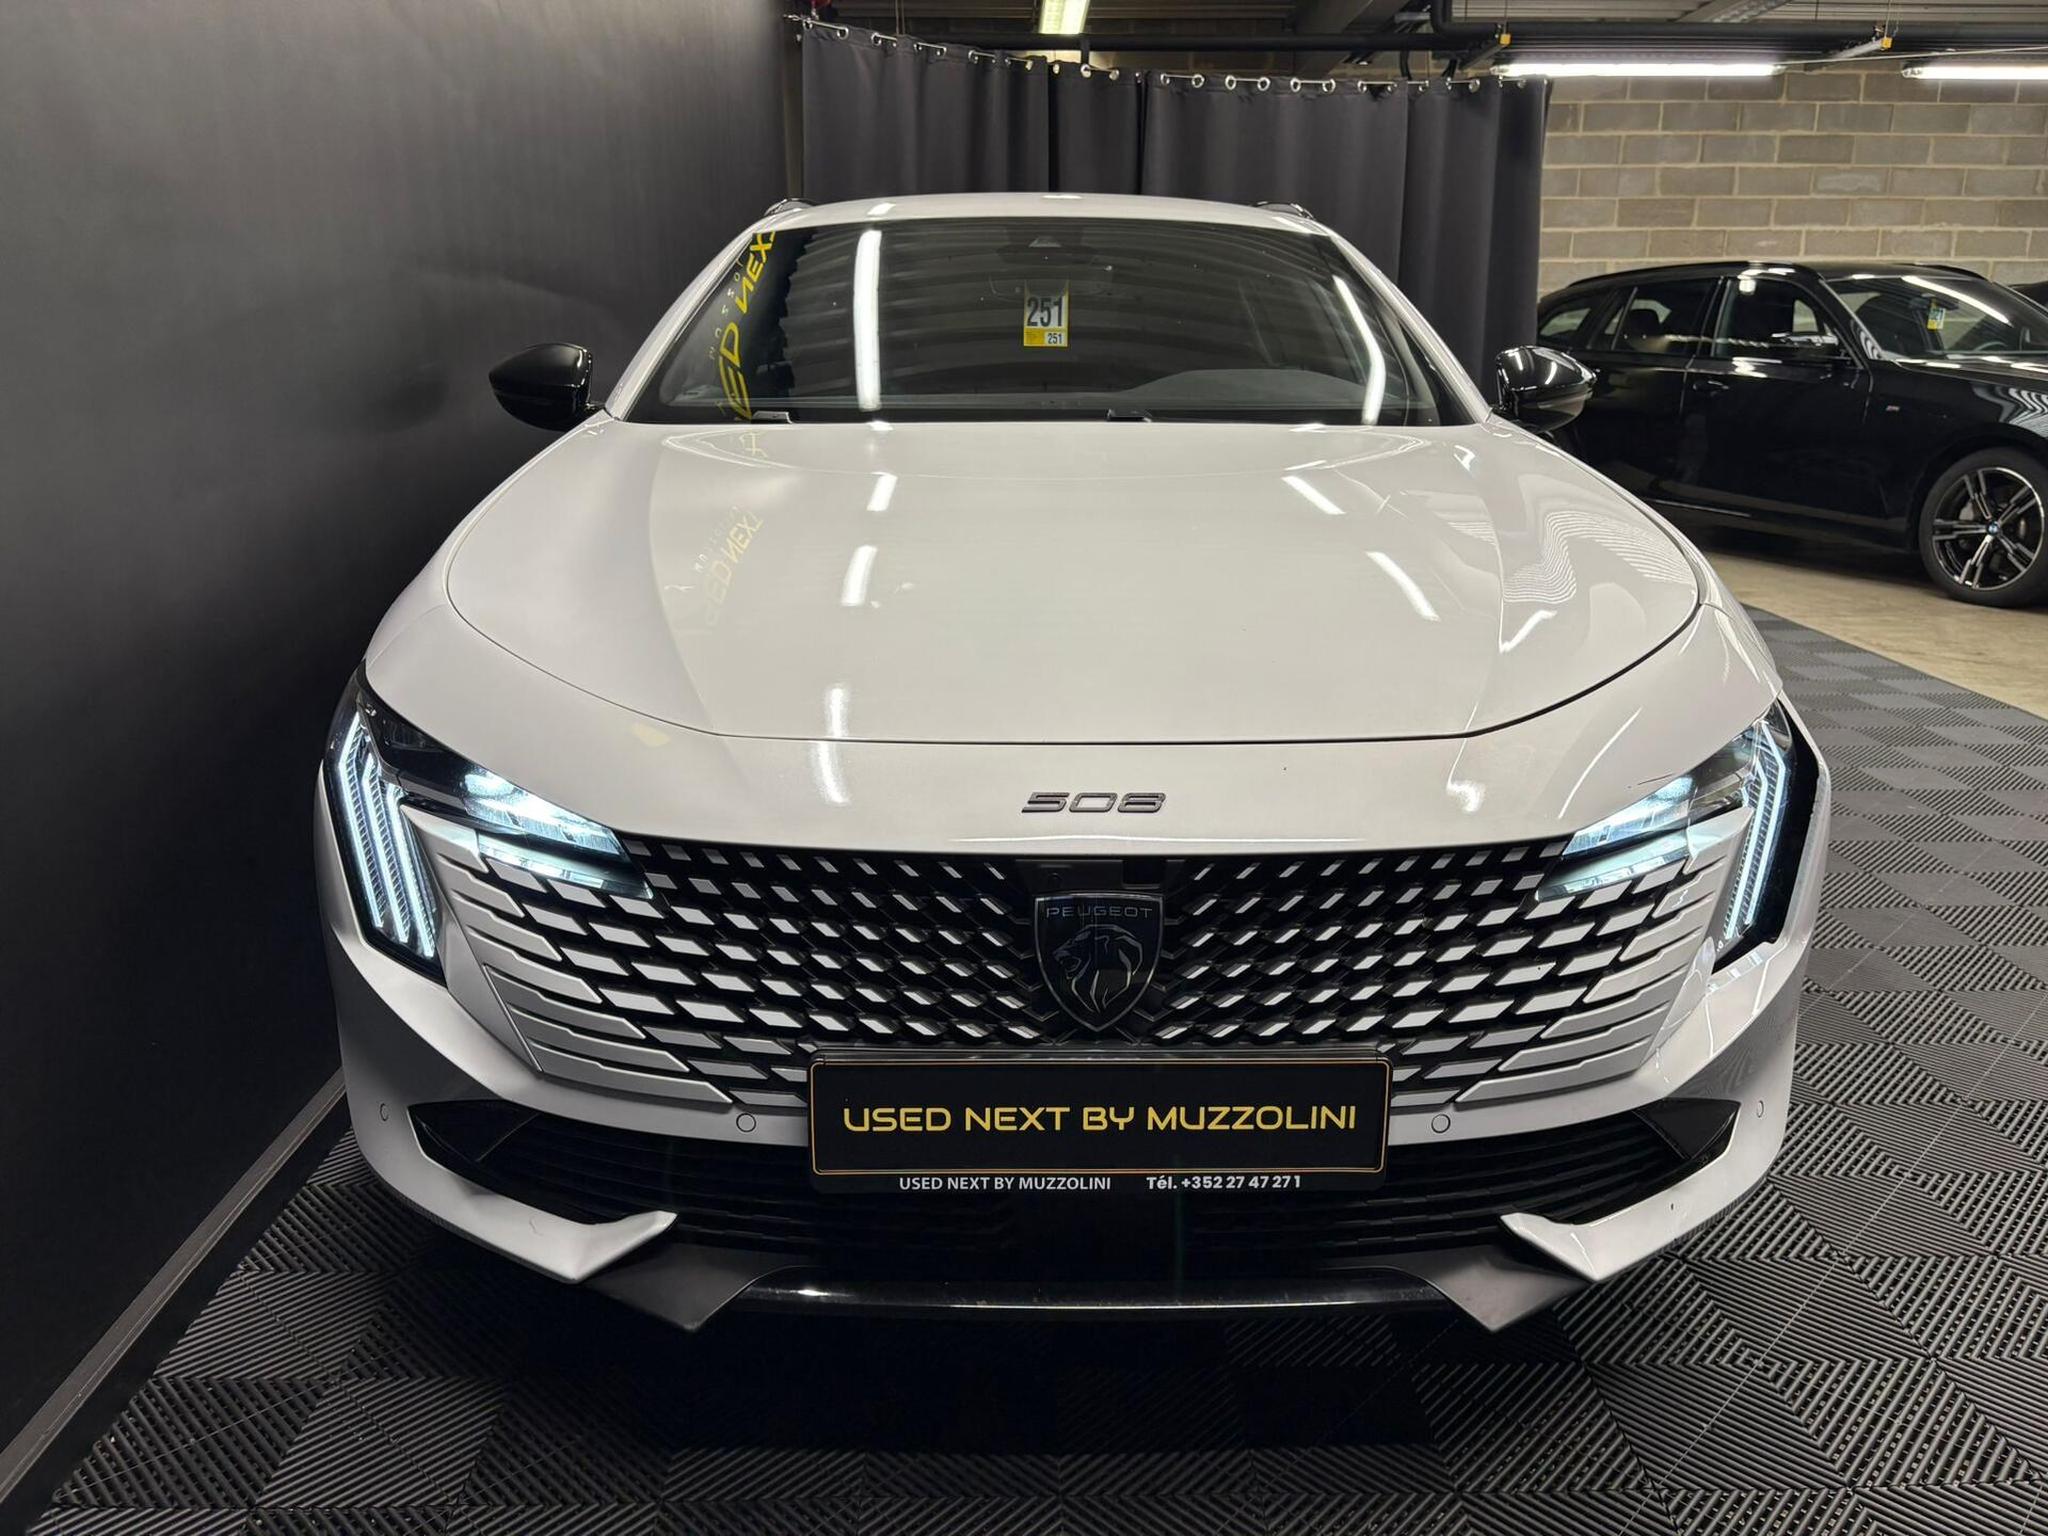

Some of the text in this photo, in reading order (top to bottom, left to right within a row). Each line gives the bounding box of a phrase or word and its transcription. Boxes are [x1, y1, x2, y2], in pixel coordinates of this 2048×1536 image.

[1027, 296, 1062, 327] 251
[1048, 333, 1062, 344] 251
[1021, 791, 1166, 813] 508
[1046, 906, 1153, 918] PEUGEOT
[843, 1105, 1356, 1132] USED NEXT BY MUZZOLINI
[899, 1177, 1111, 1190] USED NEXT BY MUZZOLINI
[1146, 1175, 1177, 1190] Tél.
[1181, 1176, 1222, 1189] +352
[1226, 1176, 1245, 1189] 27
[1248, 1175, 1269, 1189] 47
